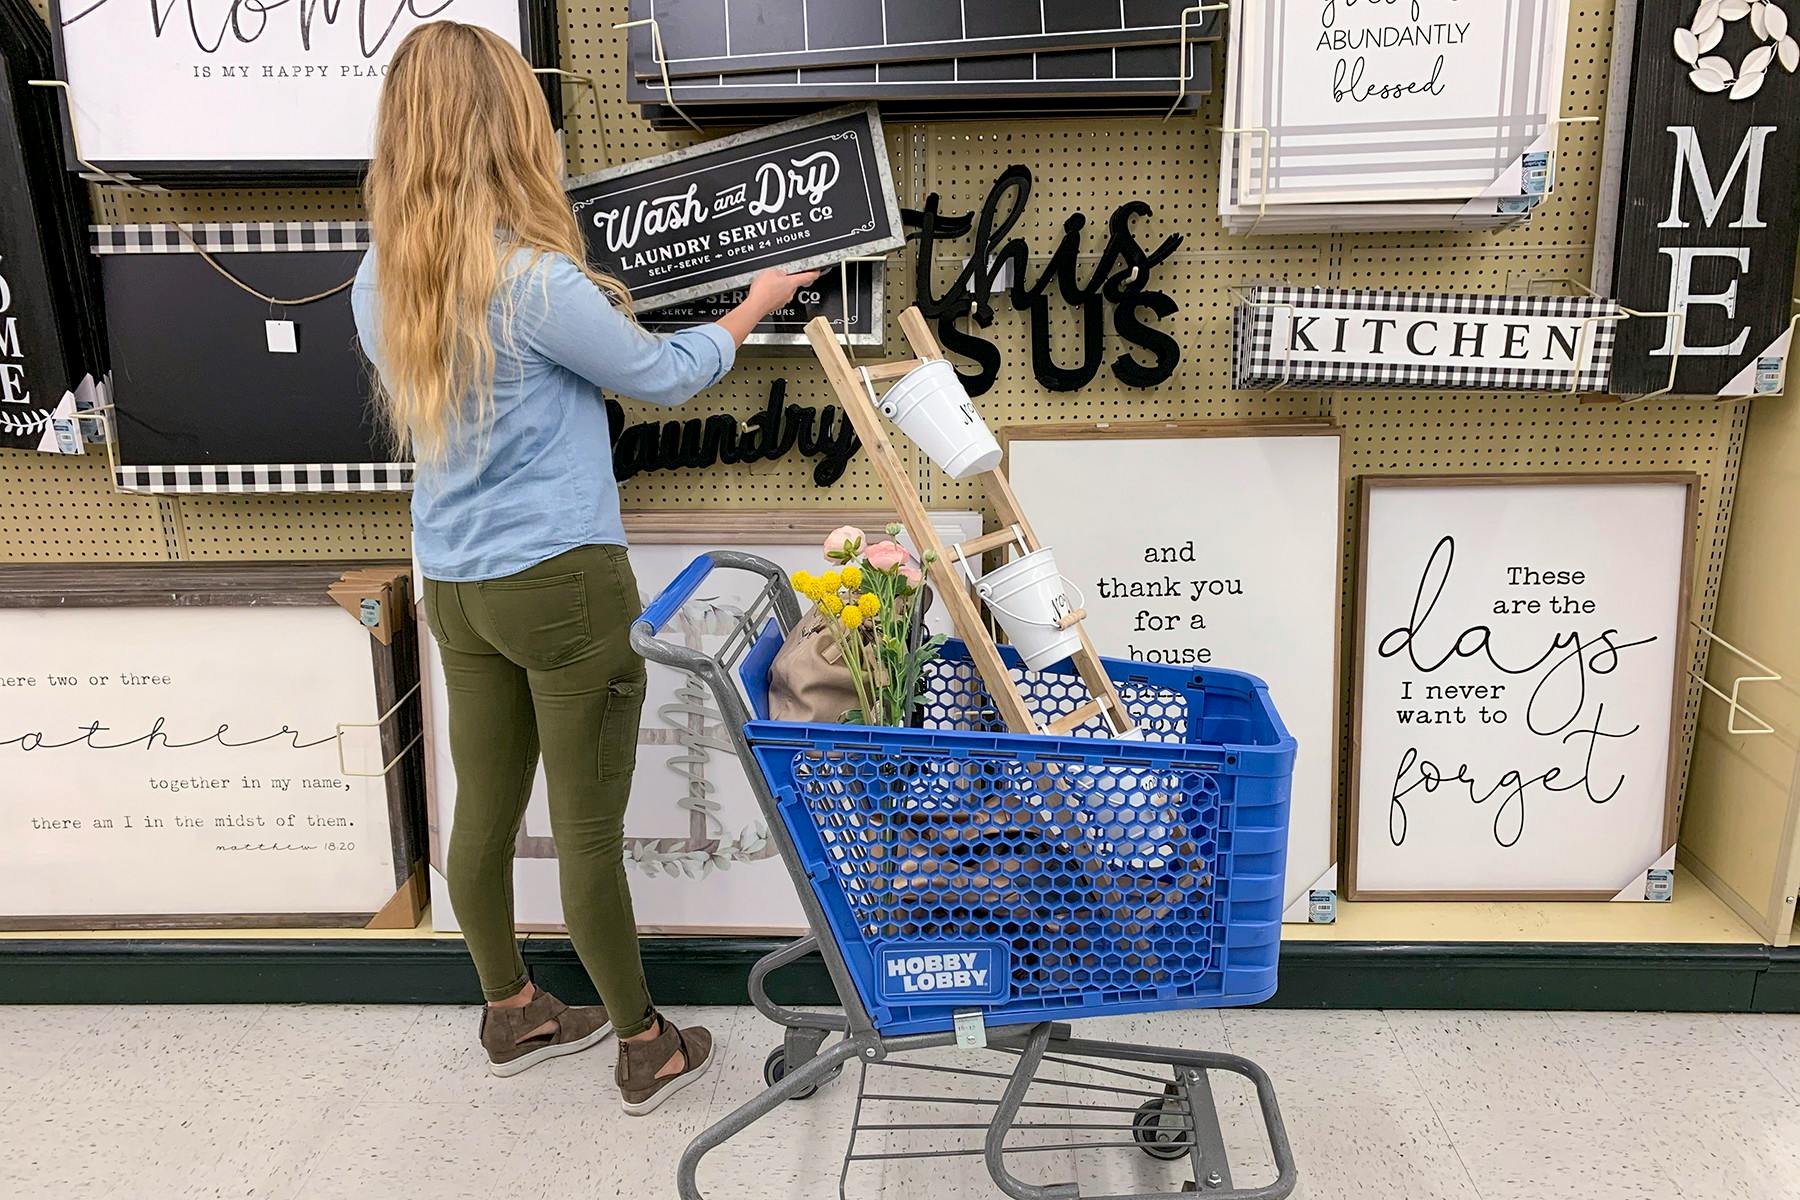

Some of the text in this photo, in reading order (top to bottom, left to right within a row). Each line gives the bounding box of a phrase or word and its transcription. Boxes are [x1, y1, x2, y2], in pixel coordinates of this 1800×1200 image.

[1316, 22, 1470, 51] ABUNDANTLY
[193, 65, 212, 78] IS
[222, 65, 250, 78] MY
[262, 65, 329, 78] HAPPY
[1333, 54, 1445, 103] blessed
[593, 150, 841, 252] Wash and Dry
[620, 206, 833, 271] LAUNDRY SERVICE Co
[900, 164, 1184, 329] this
[648, 229, 811, 276] SELF-SERVE OPEN 24 HOURS
[798, 290, 821, 304] Co
[1286, 315, 1582, 362] KITCHEN
[1143, 541, 1197, 563] and
[1506, 567, 1586, 586] These
[1096, 576, 1244, 601] thank you
[1492, 595, 1597, 615] are the
[1133, 610, 1207, 632] for a
[1378, 535, 1658, 736] days
[1127, 645, 1212, 664] house
[47, 674, 78, 687] two
[89, 676, 109, 686] or
[120, 673, 172, 686] three
[1401, 681, 1506, 700] I never
[1396, 709, 1508, 725] want to
[149, 776, 352, 792] together in my name,
[1389, 702, 1640, 848] forget
[31, 814, 355, 830] there am I in the midst of them.
[215, 842, 318, 851] matthew
[886, 952, 977, 977] HOBBY
[903, 969, 988, 992] LOBBY
